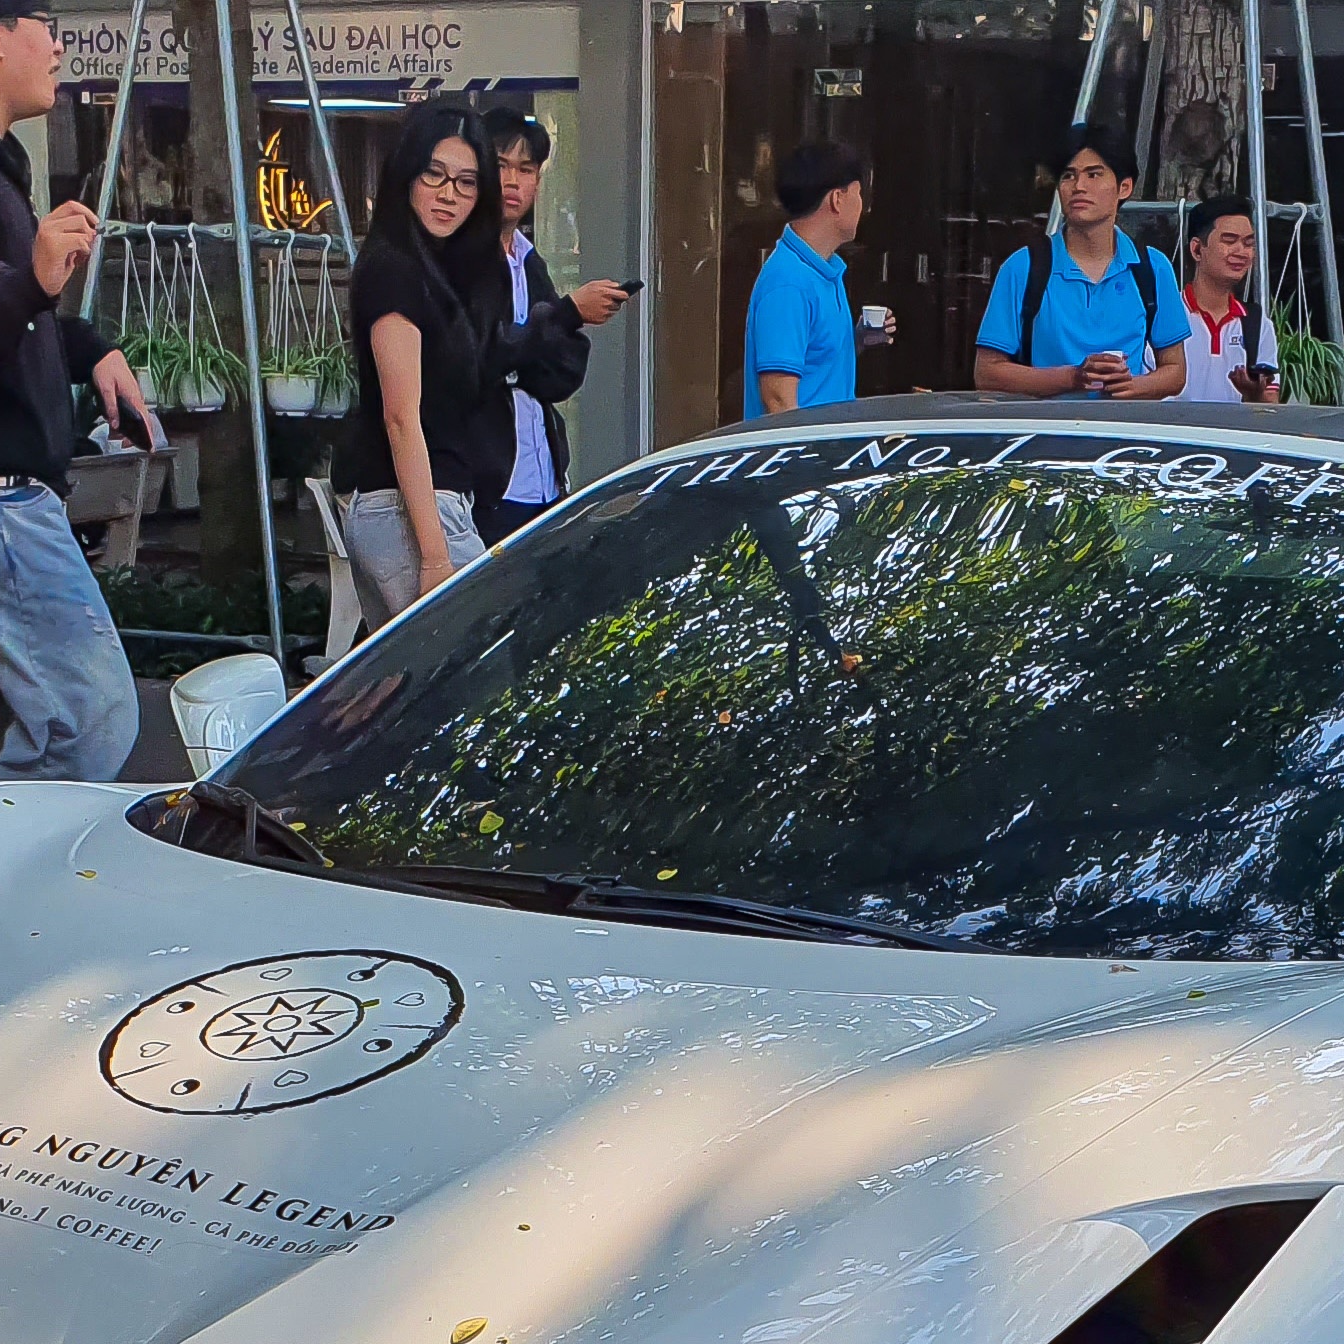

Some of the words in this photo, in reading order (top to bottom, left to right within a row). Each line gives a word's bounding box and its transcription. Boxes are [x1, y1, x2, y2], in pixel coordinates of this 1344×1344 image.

[70, 56, 123, 76] Office
[286, 54, 381, 74] Aademic
[388, 53, 454, 73] Affairs
[345, 25, 391, 55] ĐẠI
[402, 24, 461, 57] HỌC
[637, 443, 809, 496] THE
[833, 433, 1038, 472] No.1
[33, 1133, 215, 1193] NGUYÊN
[220, 1181, 396, 1232] LEGEND
[14, 1169, 56, 1188] PHÊ
[115, 1195, 186, 1225] LƯỢNG
[205, 1222, 232, 1238] CÀ
[235, 1230, 280, 1249] PHÊ
[56, 1214, 163, 1254] COFFEE!
